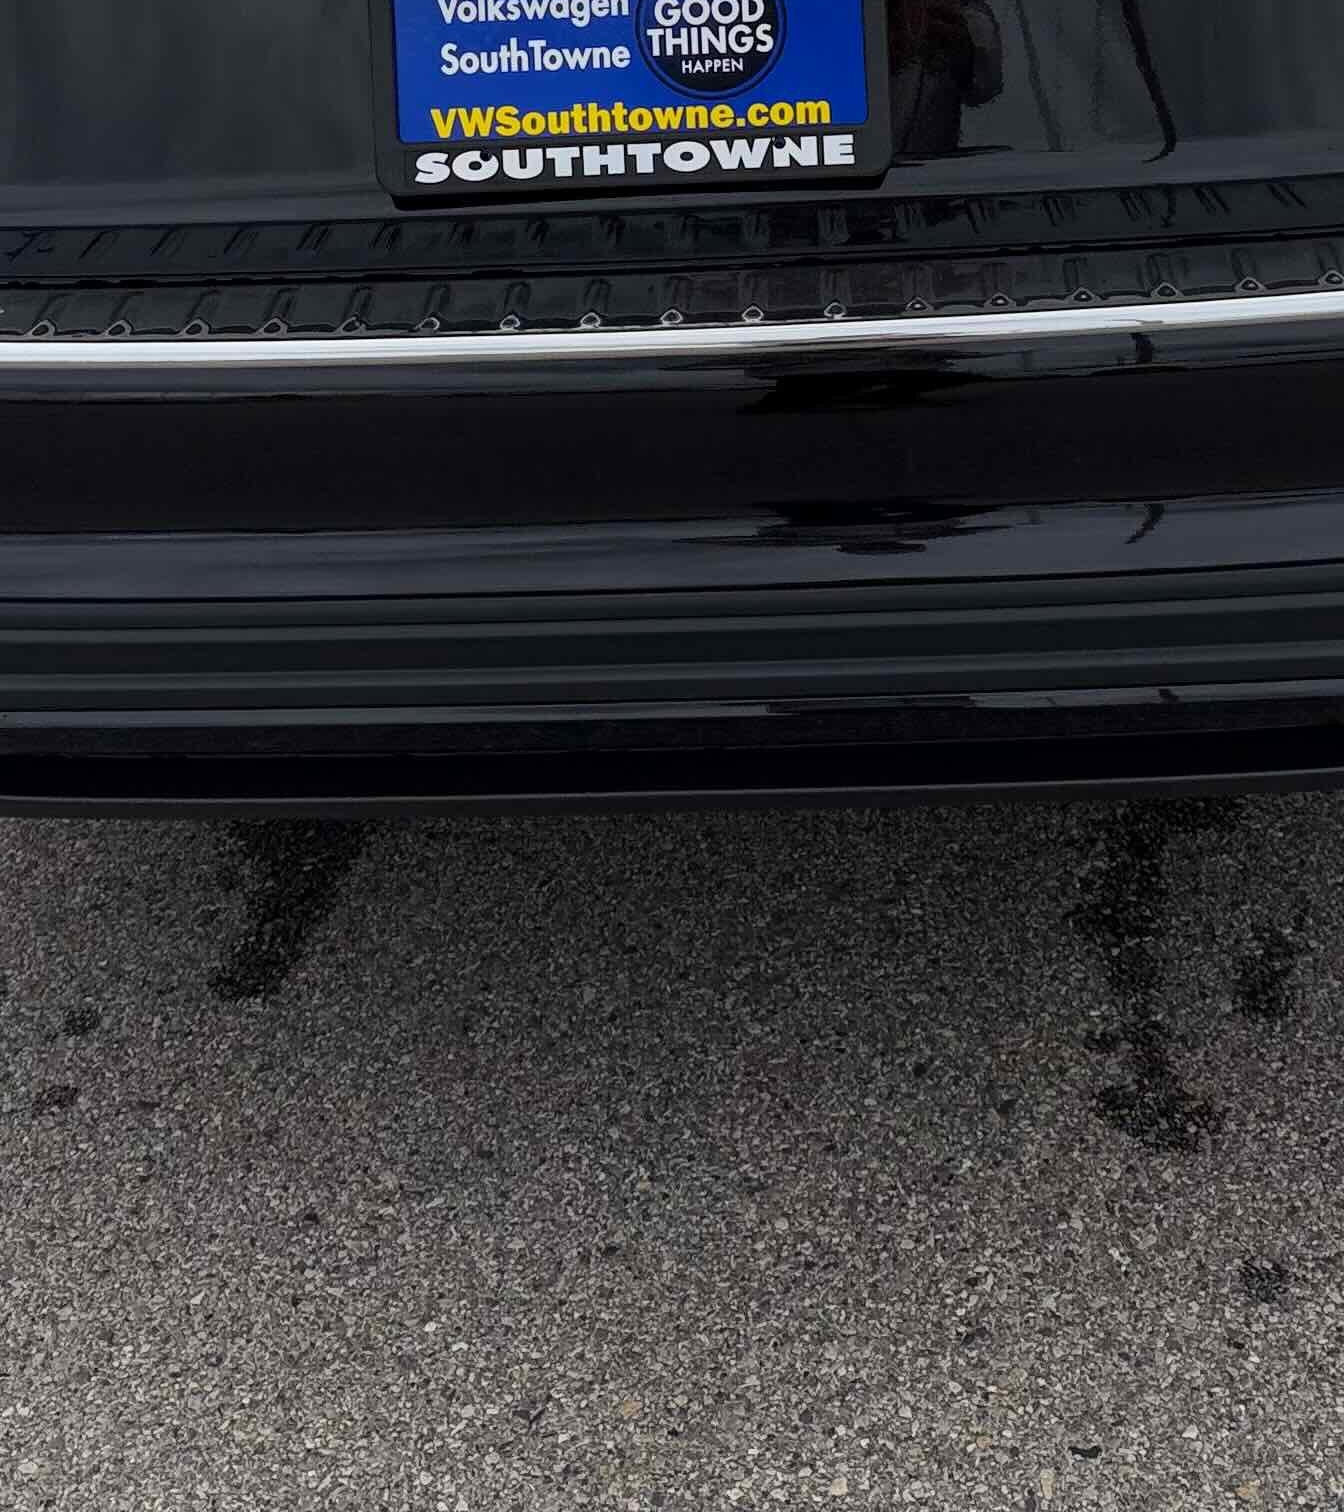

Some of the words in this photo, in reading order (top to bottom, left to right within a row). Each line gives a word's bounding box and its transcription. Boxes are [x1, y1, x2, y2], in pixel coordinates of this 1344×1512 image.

[440, 37, 632, 77] SouthTowne
[646, 23, 775, 56] THINGS
[680, 57, 744, 75] HAPPEN
[430, 99, 832, 140] VWSouthtowne.com
[414, 133, 857, 185] SOUTHTOWNE
